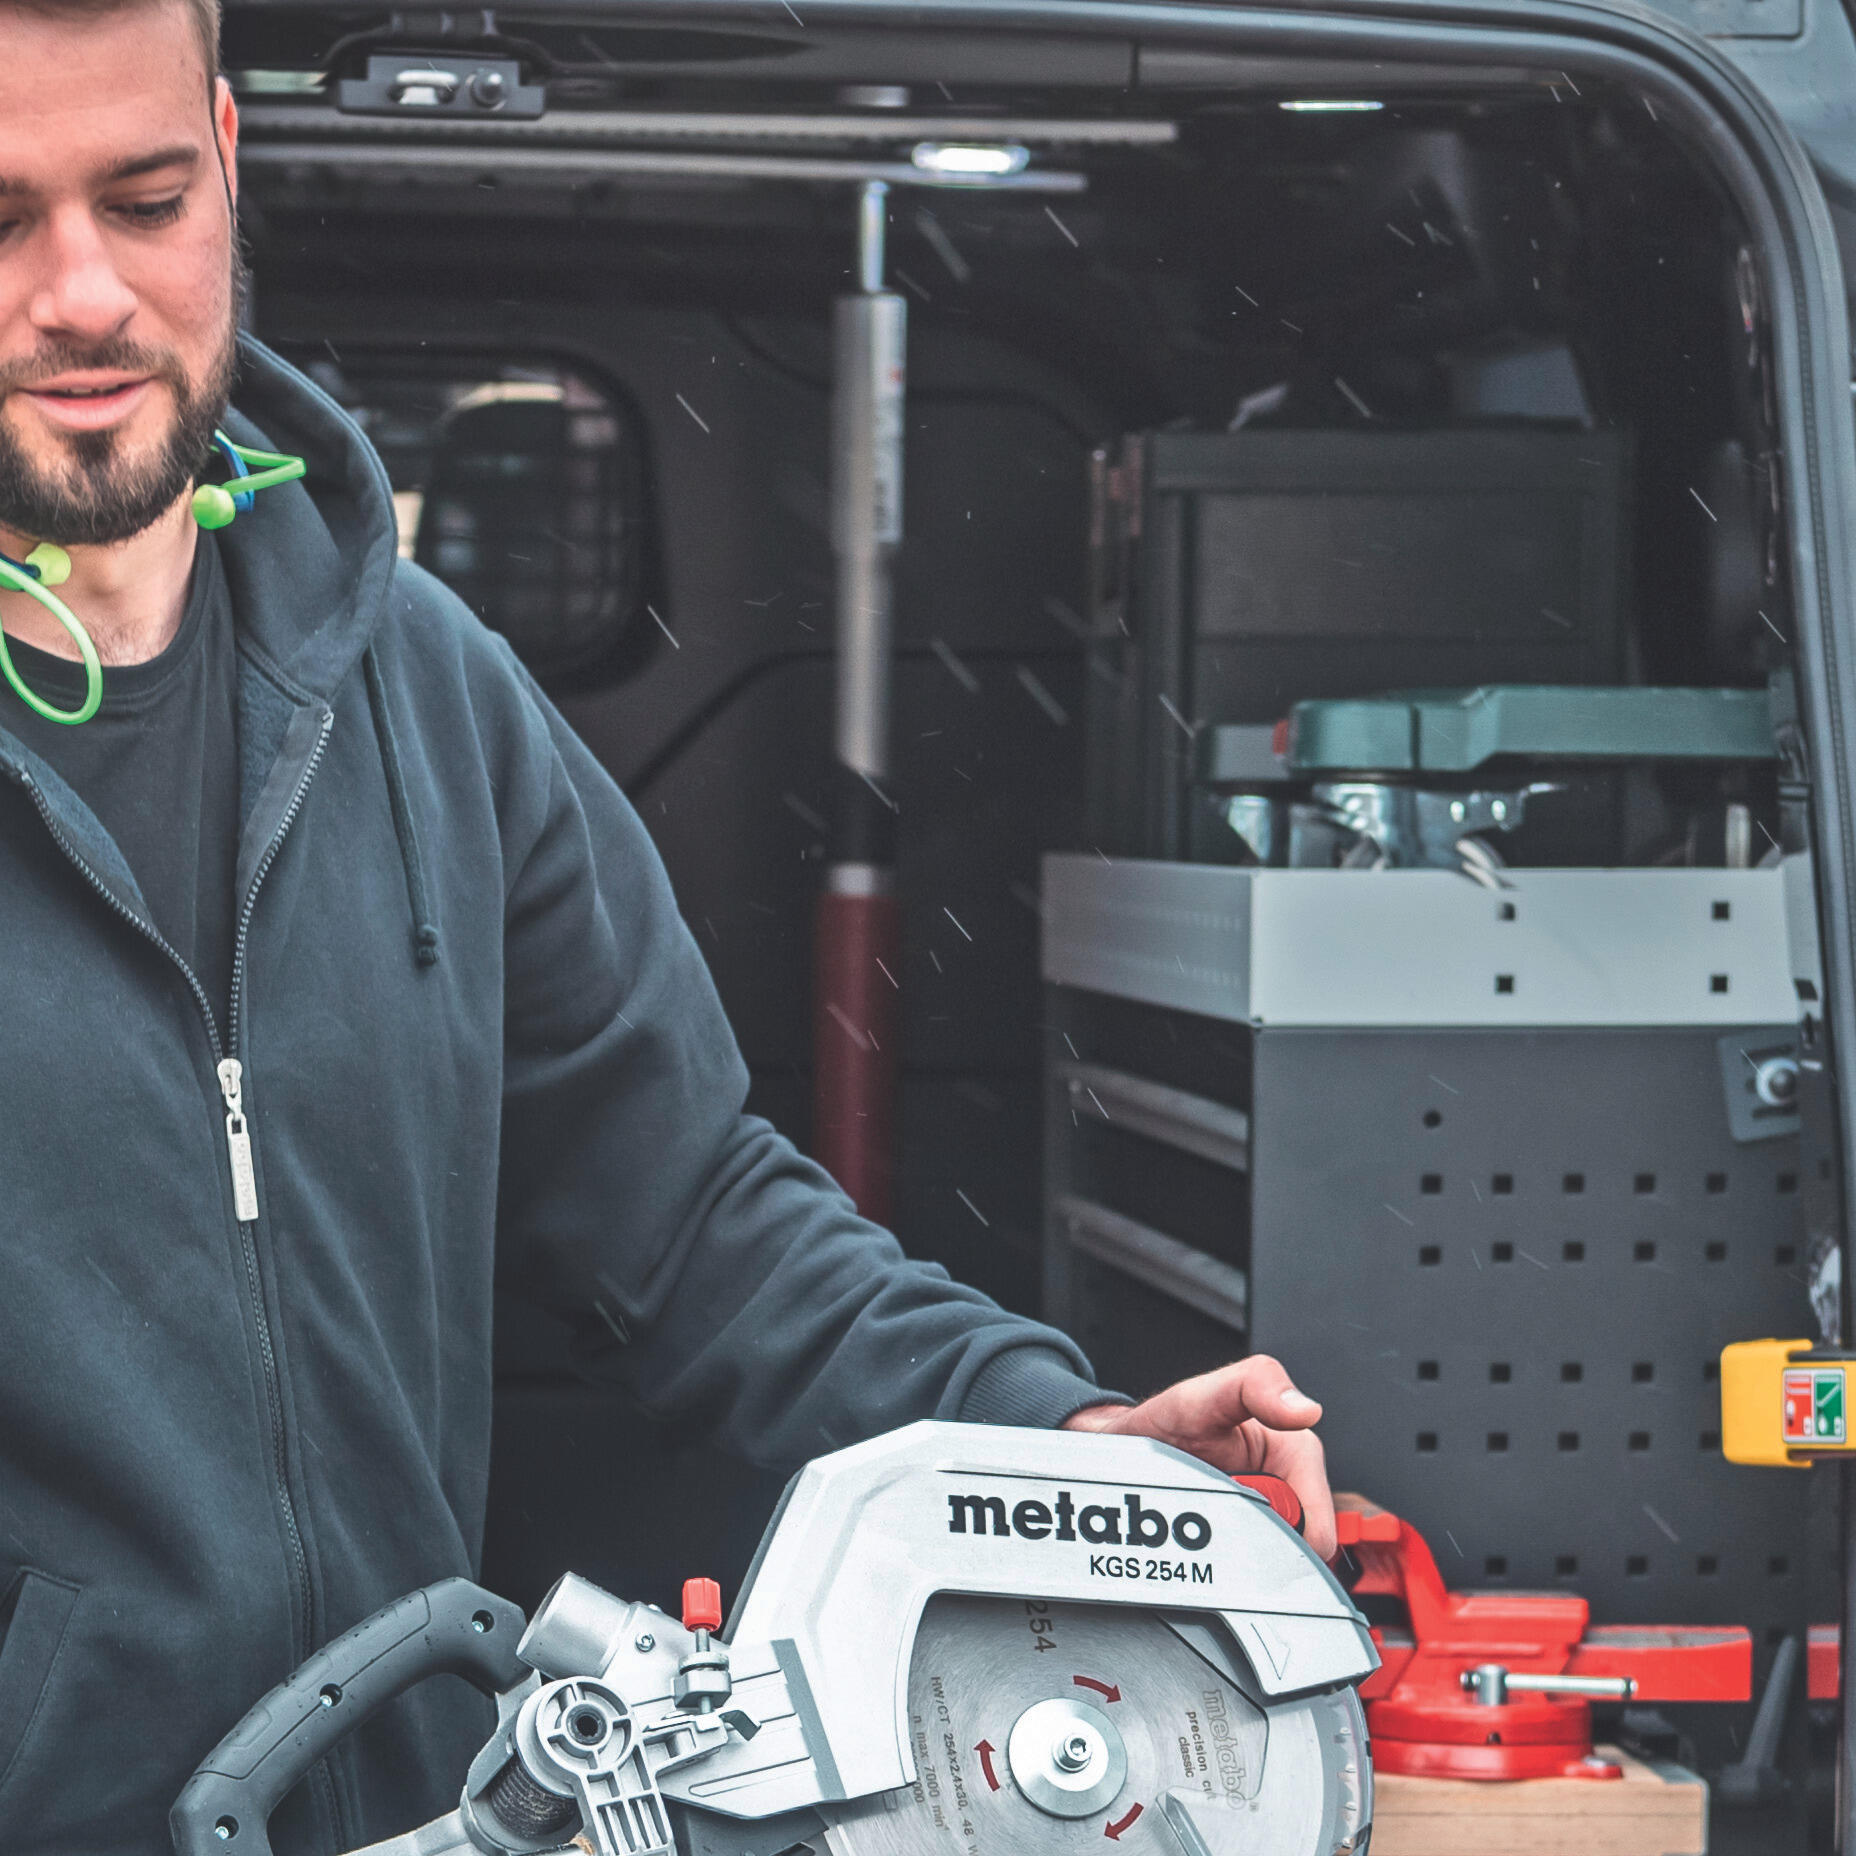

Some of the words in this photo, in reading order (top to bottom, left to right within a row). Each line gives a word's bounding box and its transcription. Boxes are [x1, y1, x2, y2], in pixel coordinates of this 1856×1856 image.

[948, 1491, 1212, 1551] metabo
[1090, 1555, 1140, 1578] KGS
[1145, 1560, 1187, 1582] 254
[1193, 1563, 1213, 1584] M
[1025, 1600, 1057, 1652] 254
[931, 1676, 951, 1724] HW/CT
[916, 1731, 929, 1758] max
[923, 1766, 941, 1798] 7000
[1178, 1736, 1194, 1778] classic
[1185, 1711, 1208, 1771] precision
[1203, 1689, 1247, 1810] metabo
